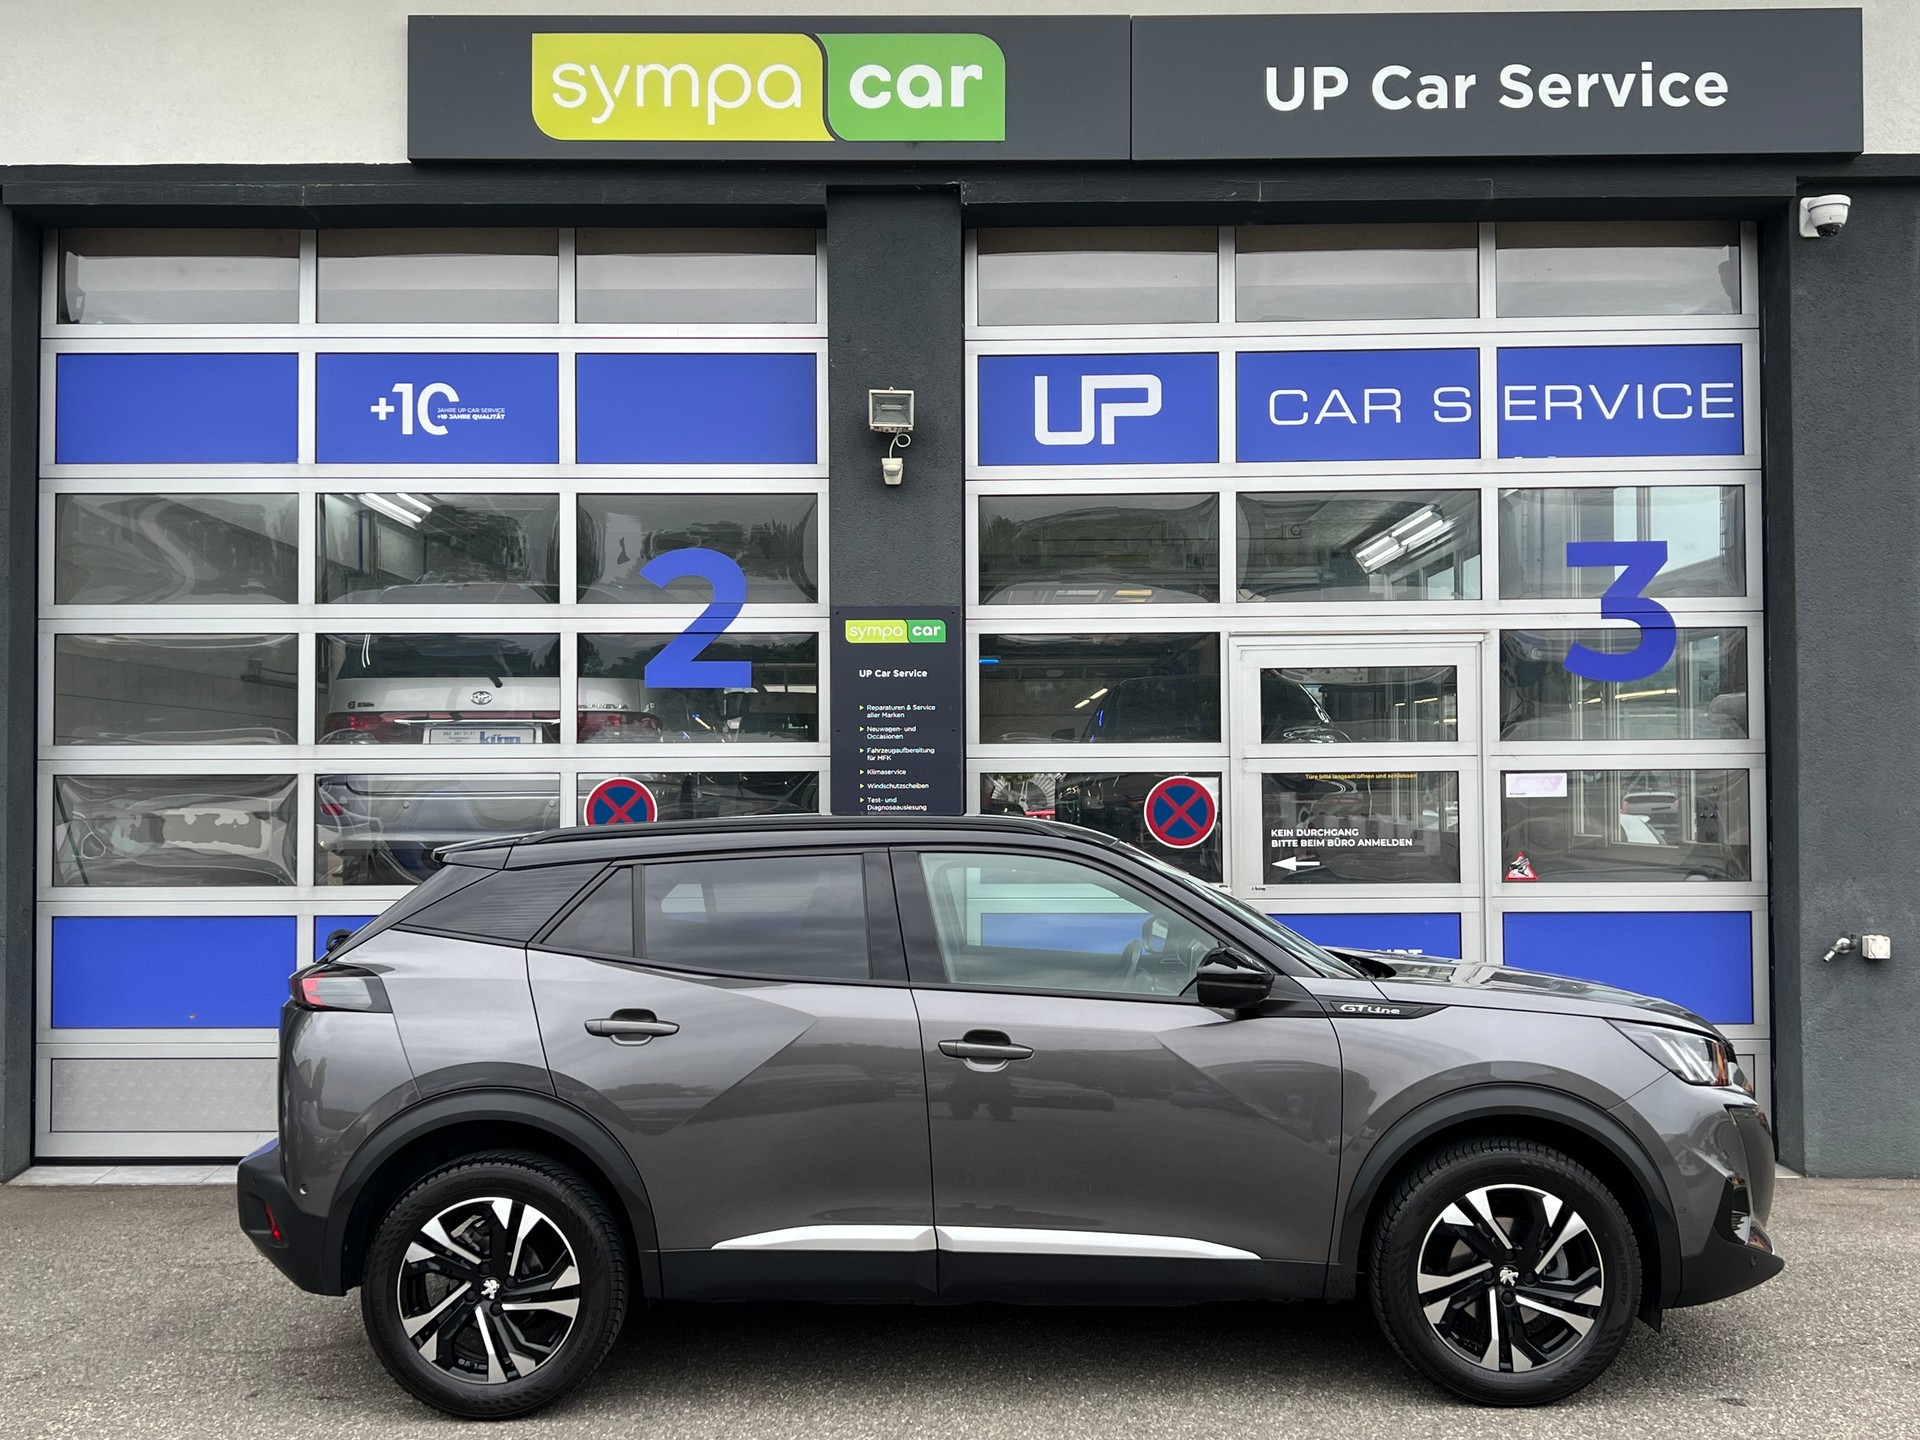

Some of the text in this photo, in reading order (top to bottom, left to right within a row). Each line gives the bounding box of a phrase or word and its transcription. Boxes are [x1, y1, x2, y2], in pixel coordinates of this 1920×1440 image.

[1266, 61, 1730, 112] UP Car Service
[552, 62, 984, 126] sympa car
[1034, 374, 1736, 446] UP CAR SERVICE
[471, 412, 506, 421] QUALITÄT
[1562, 540, 1677, 683] 3
[639, 547, 753, 689] 2
[849, 625, 942, 640] sympa car
[859, 668, 928, 678] UP Car Service
[866, 704, 906, 712] Reparaturen
[866, 725, 903, 733] Neuwagen-
[866, 747, 936, 755] Fahrzeugaufbereitung
[866, 782, 930, 790] Windschutzscheiben
[866, 804, 928, 812] Diagnoseauslesung
[1270, 828, 1359, 838] KEIN DURCHGANG
[1271, 836, 1413, 848] BITTE BEIM BÜRO ANMELDEN
